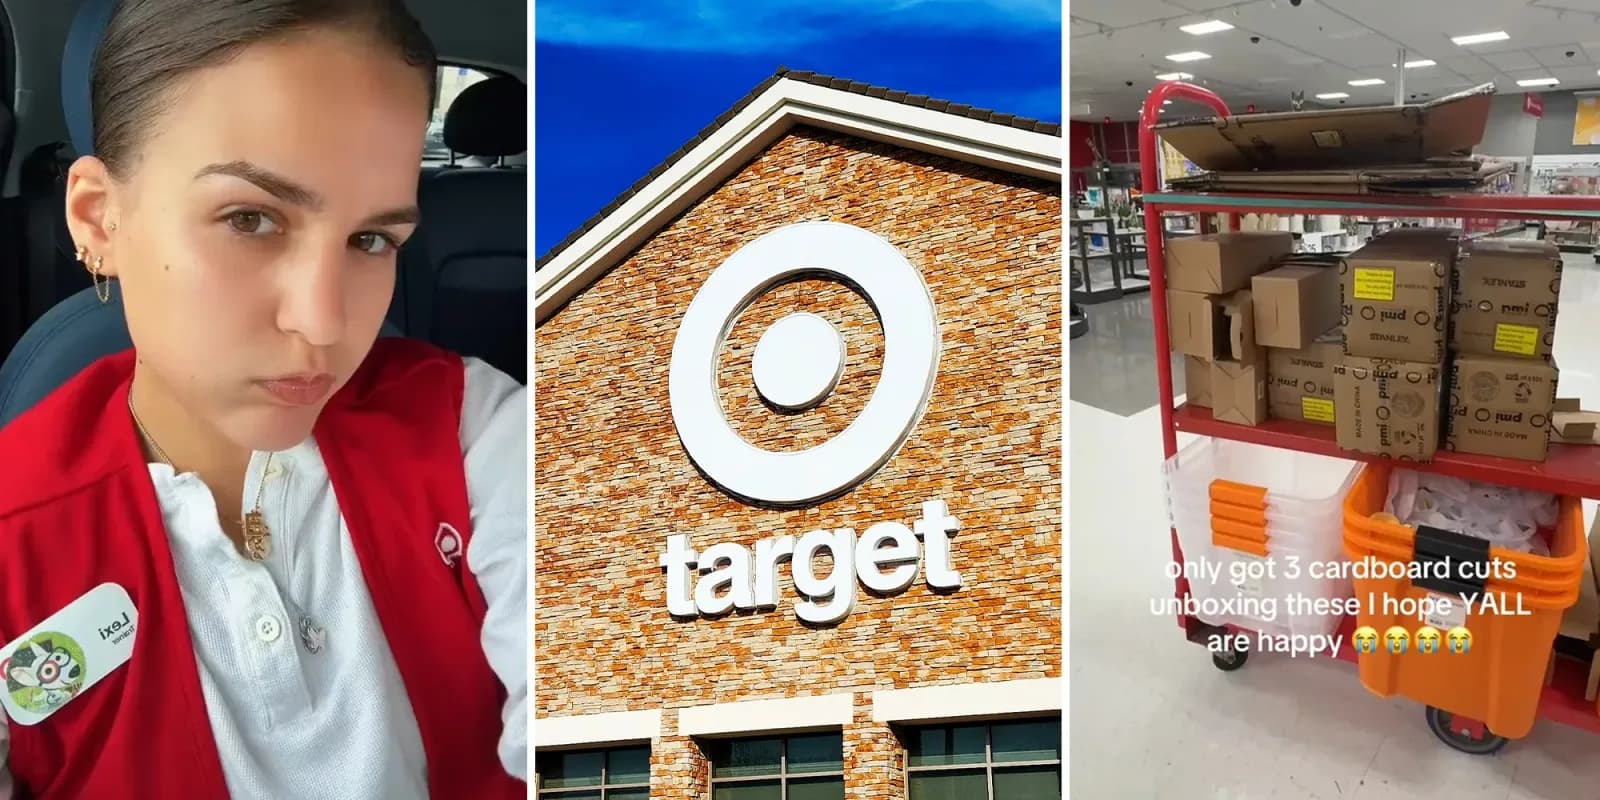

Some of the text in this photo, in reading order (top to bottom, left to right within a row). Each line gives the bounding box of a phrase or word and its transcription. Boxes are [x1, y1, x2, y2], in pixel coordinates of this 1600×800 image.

[1501, 302, 1530, 314] pmi
[1380, 309, 1407, 322] pmi
[1277, 378, 1298, 387] pmi
[1495, 412, 1523, 424] pmi
[1376, 424, 1391, 447] pmi
[659, 499, 962, 624] target
